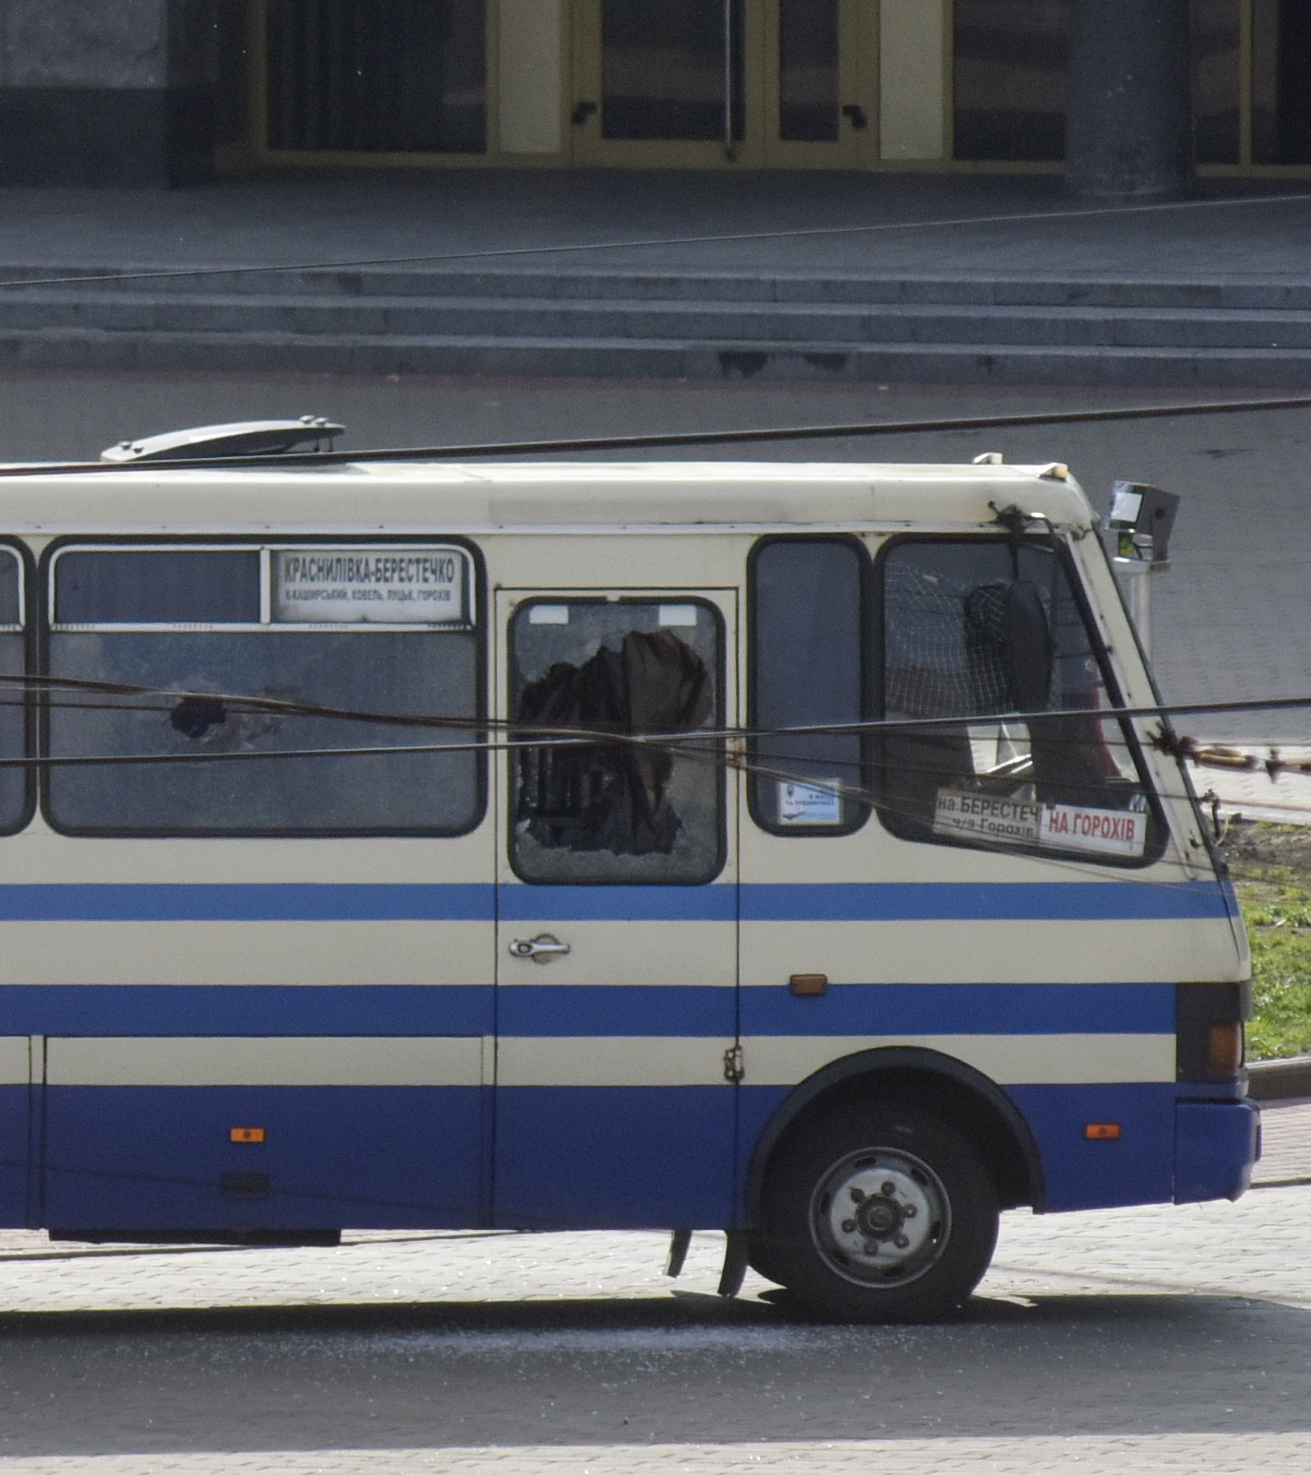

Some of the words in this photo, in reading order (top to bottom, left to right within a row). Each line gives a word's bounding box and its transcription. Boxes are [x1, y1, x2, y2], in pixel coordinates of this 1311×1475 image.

[284, 557, 455, 583] КРАСНИЛІВКА-БЕРЕСТЕЧКО
[961, 796, 1041, 822] БЕРЕСТЕЧ
[980, 818, 1034, 836] Горохів
[1049, 810, 1068, 834] НА
[1073, 813, 1135, 841] ГОРОХІВ
